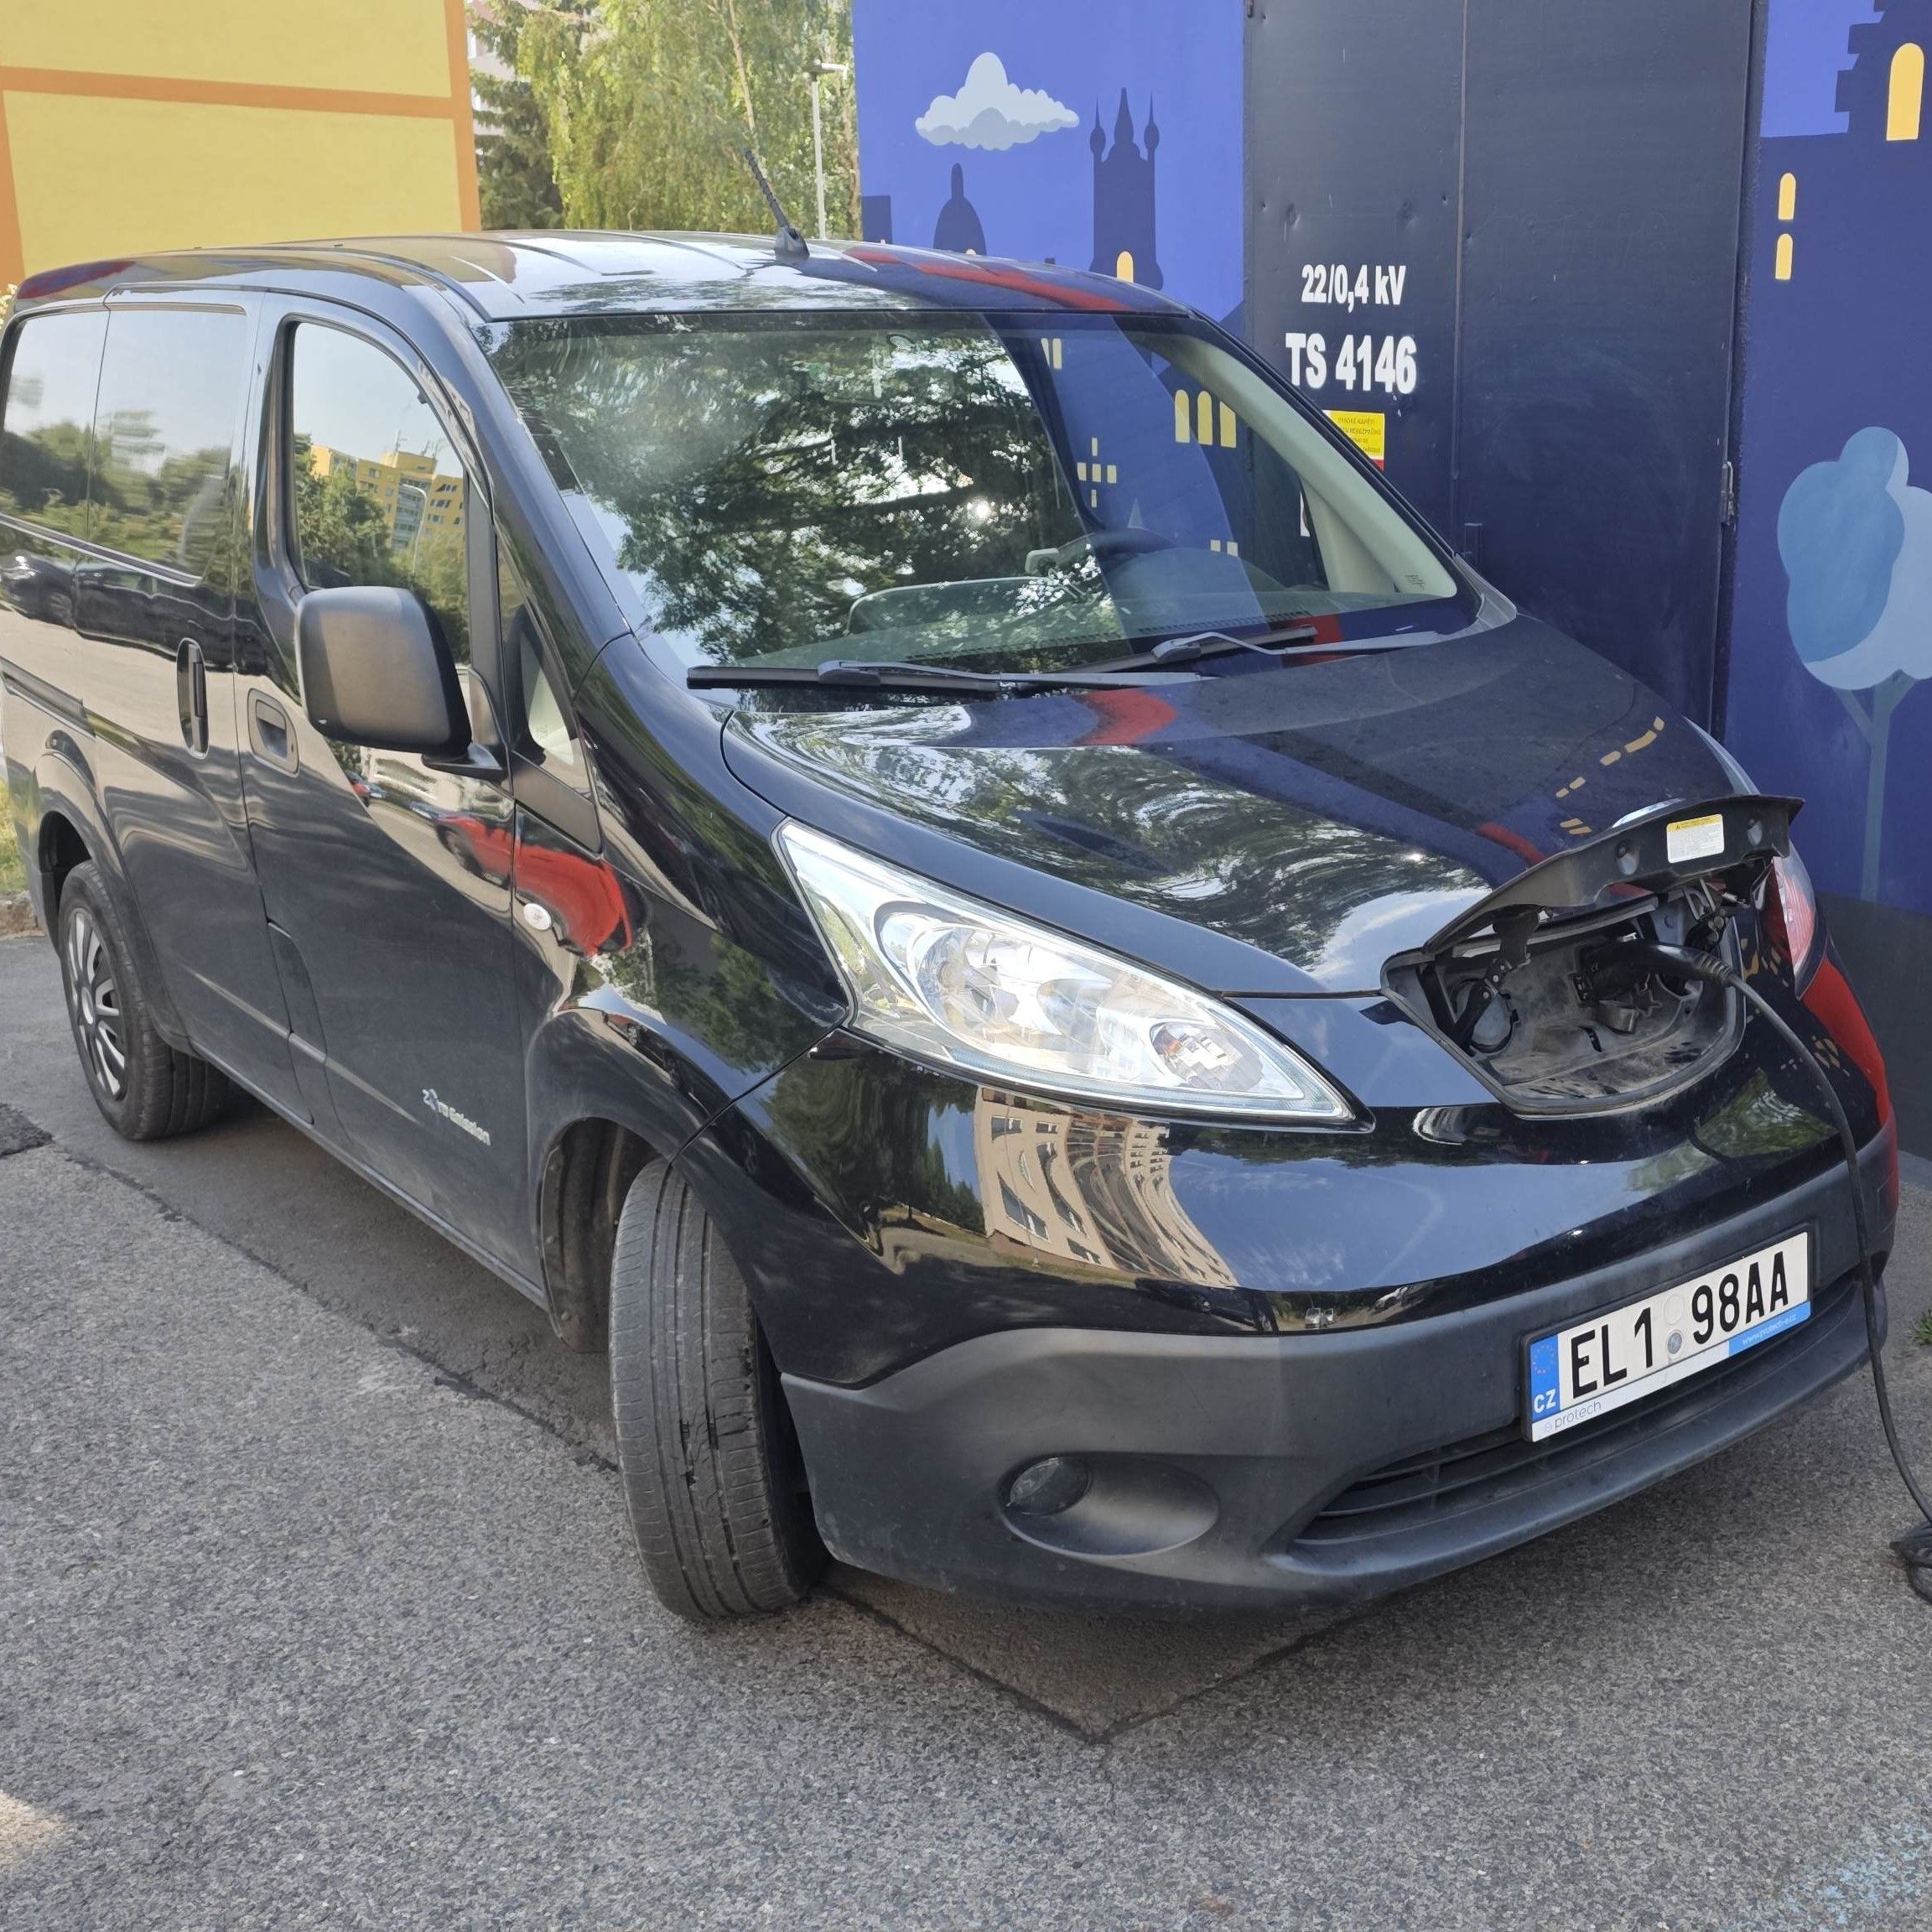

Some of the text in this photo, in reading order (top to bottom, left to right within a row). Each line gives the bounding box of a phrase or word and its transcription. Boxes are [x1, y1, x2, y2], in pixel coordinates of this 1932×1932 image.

[1301, 263, 1406, 313] 22/0,4 kV
[1285, 332, 1417, 394] TS 4146
[1691, 1251, 1789, 1344] 98AA
[1534, 1388, 1556, 1413] CZ
